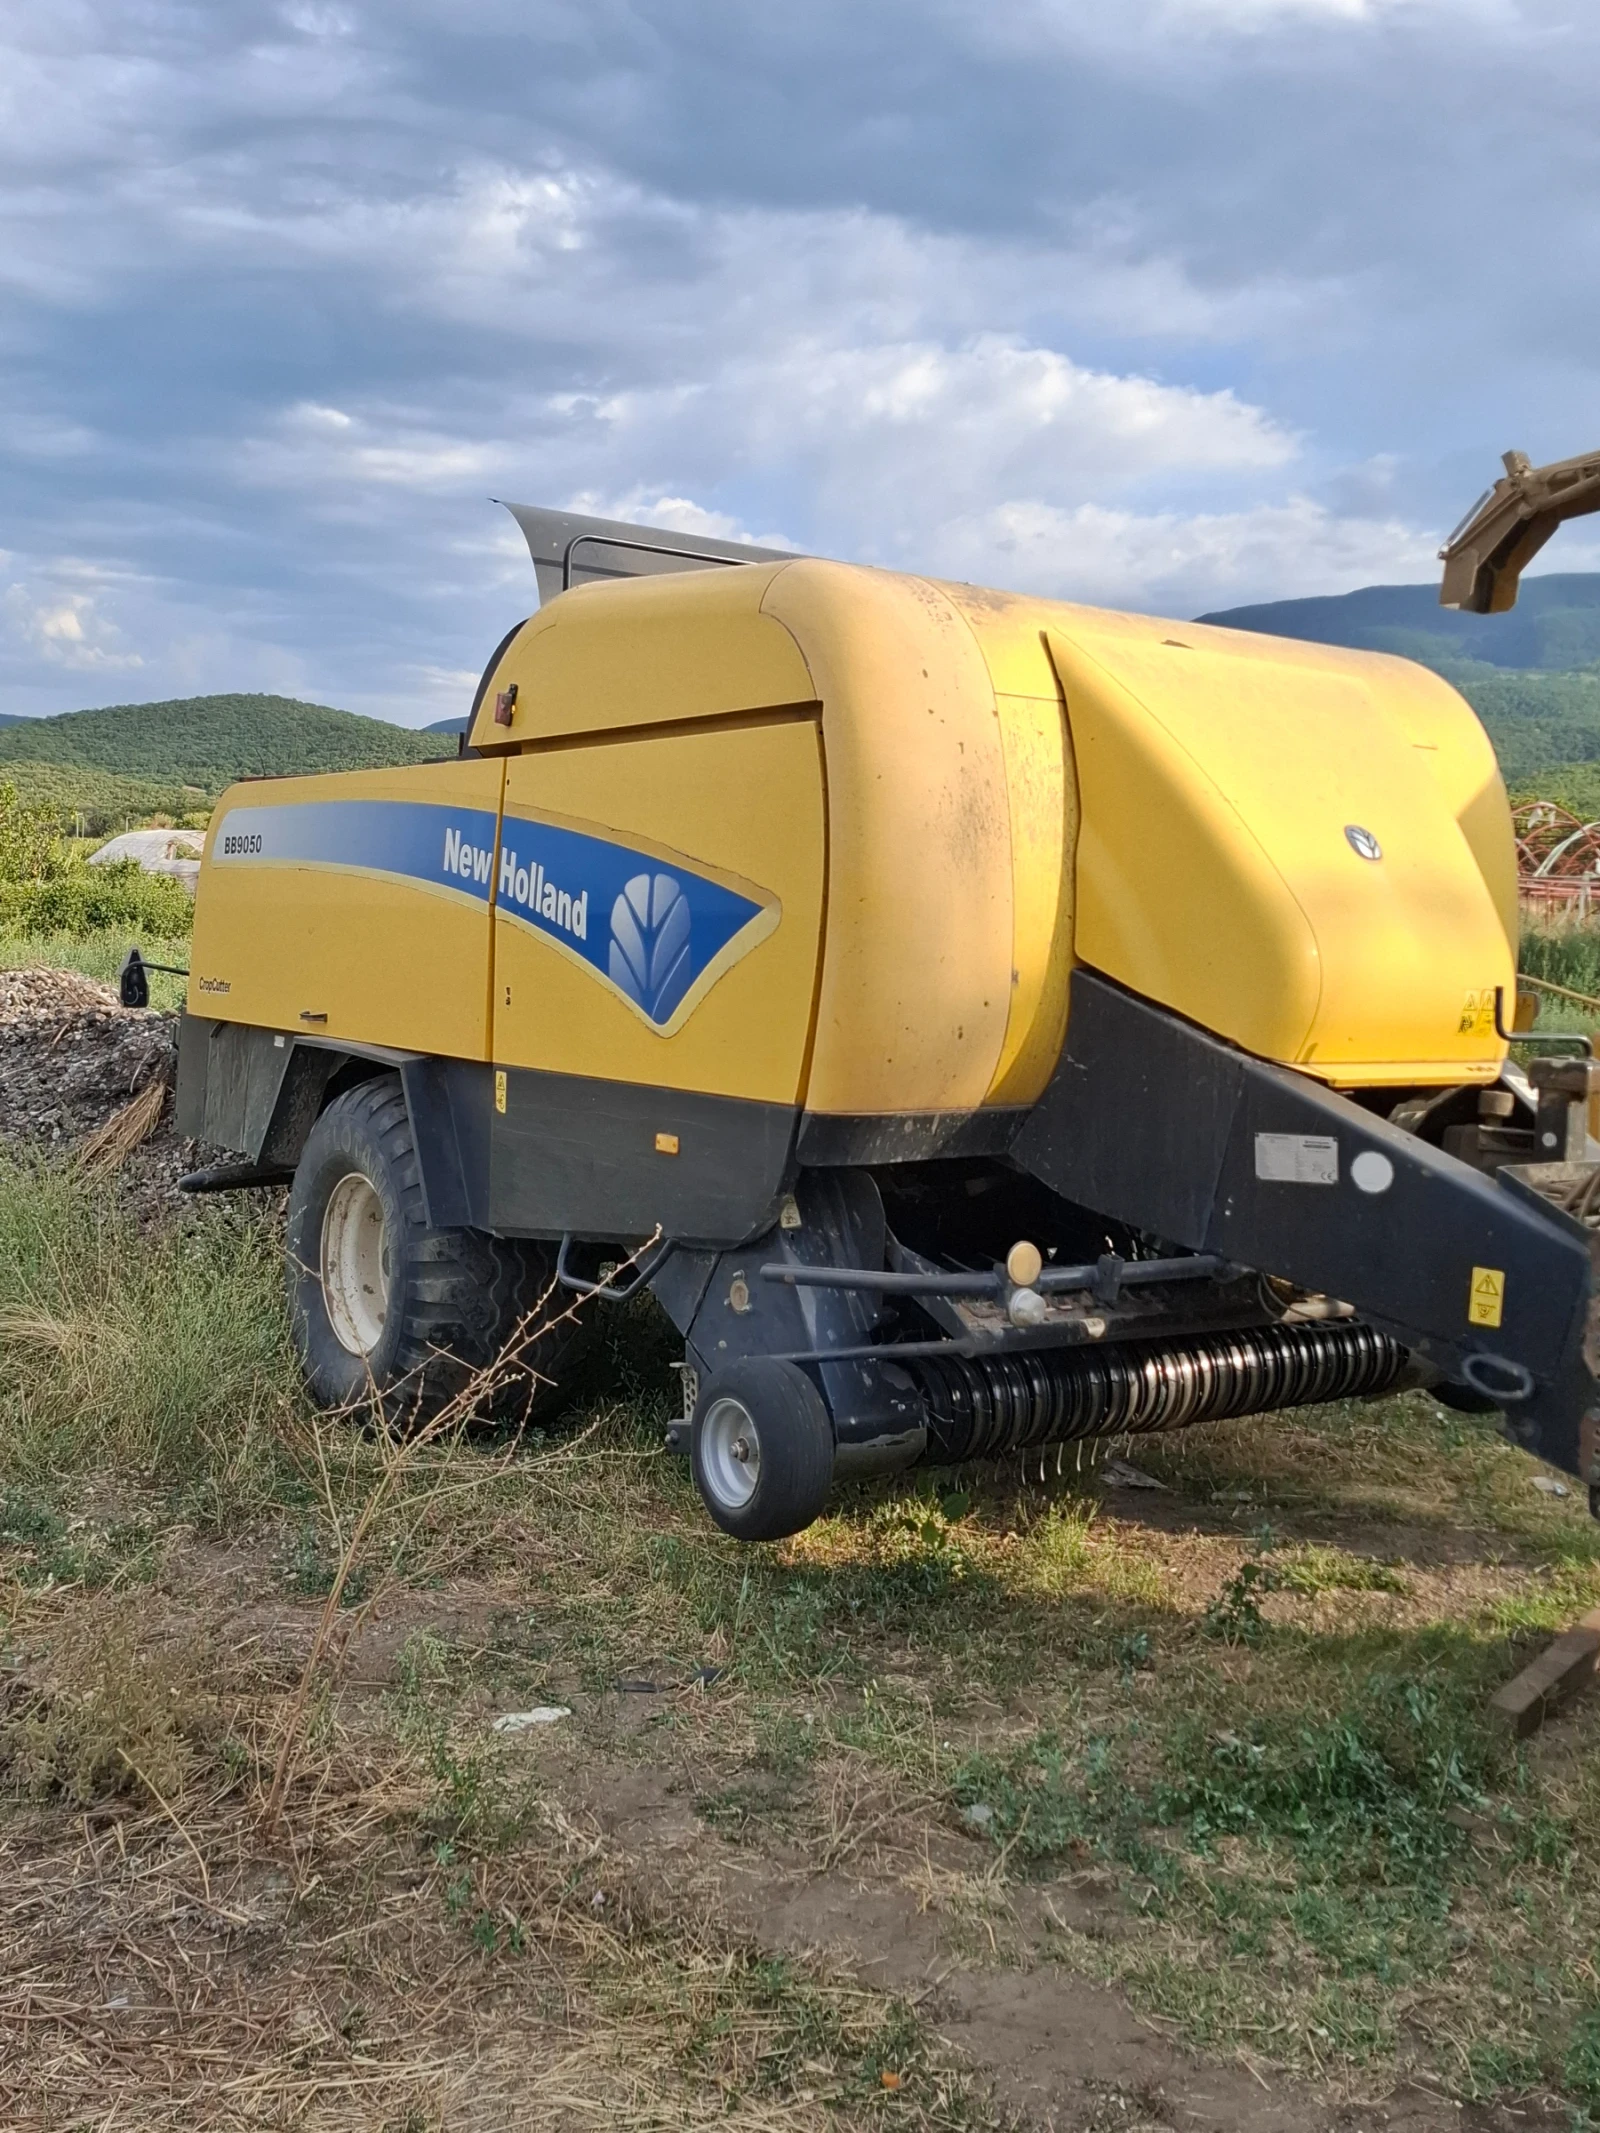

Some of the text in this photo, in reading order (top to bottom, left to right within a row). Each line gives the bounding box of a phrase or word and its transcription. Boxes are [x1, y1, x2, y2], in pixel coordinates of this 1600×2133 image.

[224, 834, 262, 855] BB9050
[443, 827, 588, 941] New Holland
[199, 976, 232, 995] CropCutter
